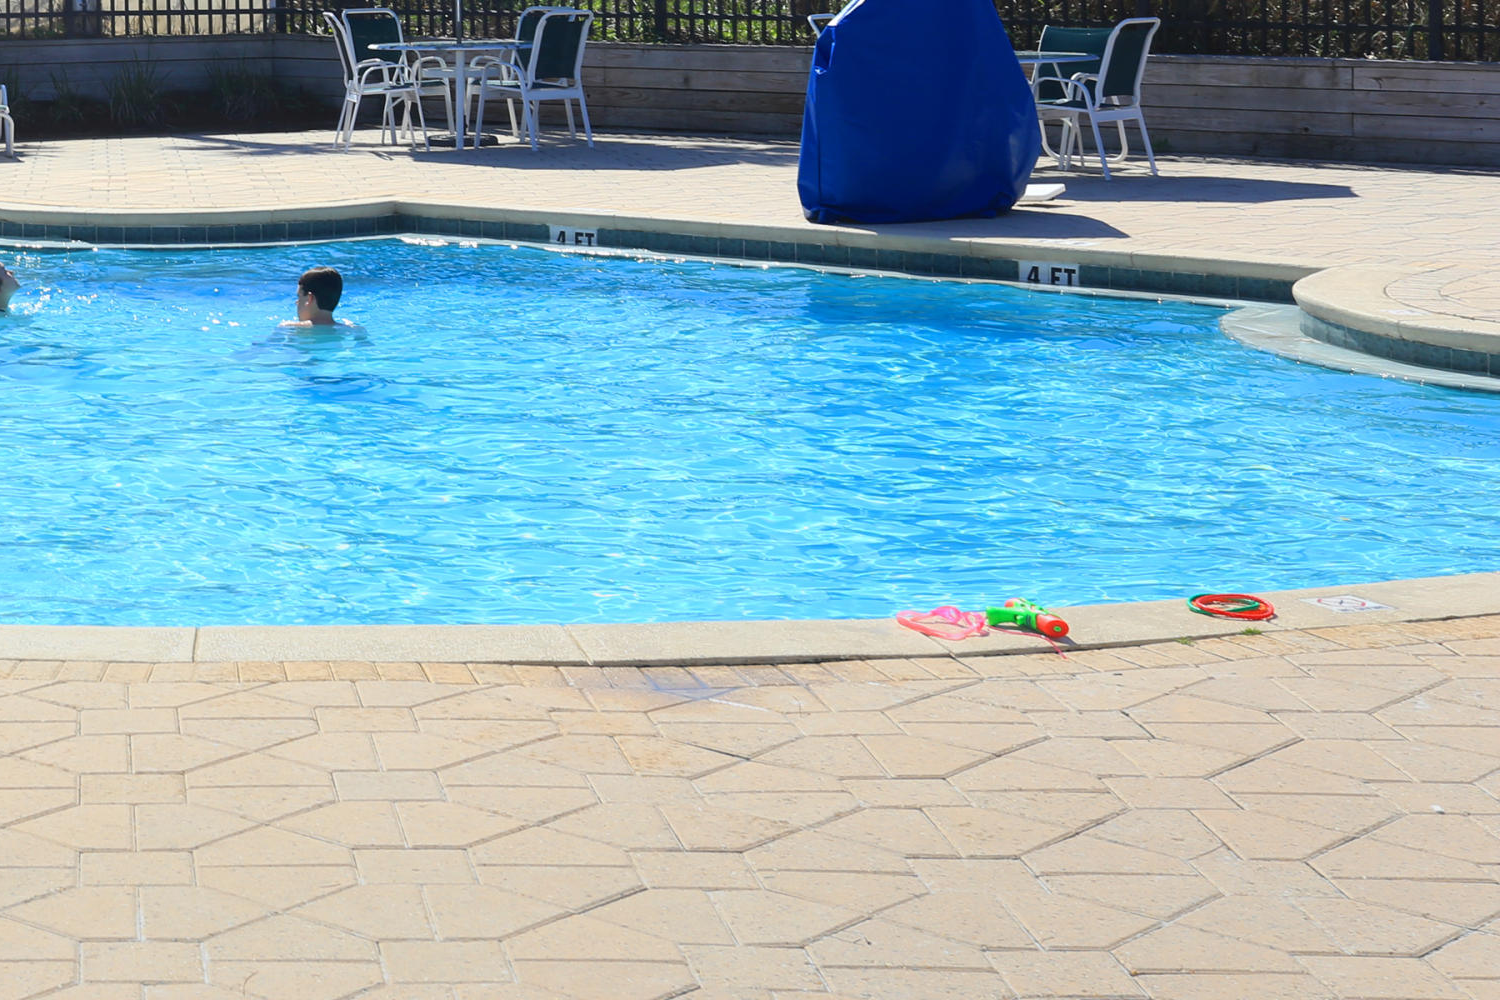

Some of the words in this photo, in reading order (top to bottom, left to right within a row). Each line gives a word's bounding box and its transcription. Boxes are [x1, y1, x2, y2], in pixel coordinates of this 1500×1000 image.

[556, 230, 566, 244] 4
[575, 231, 595, 246] FT
[1027, 265, 1040, 283] 4
[1050, 267, 1076, 286] FT
